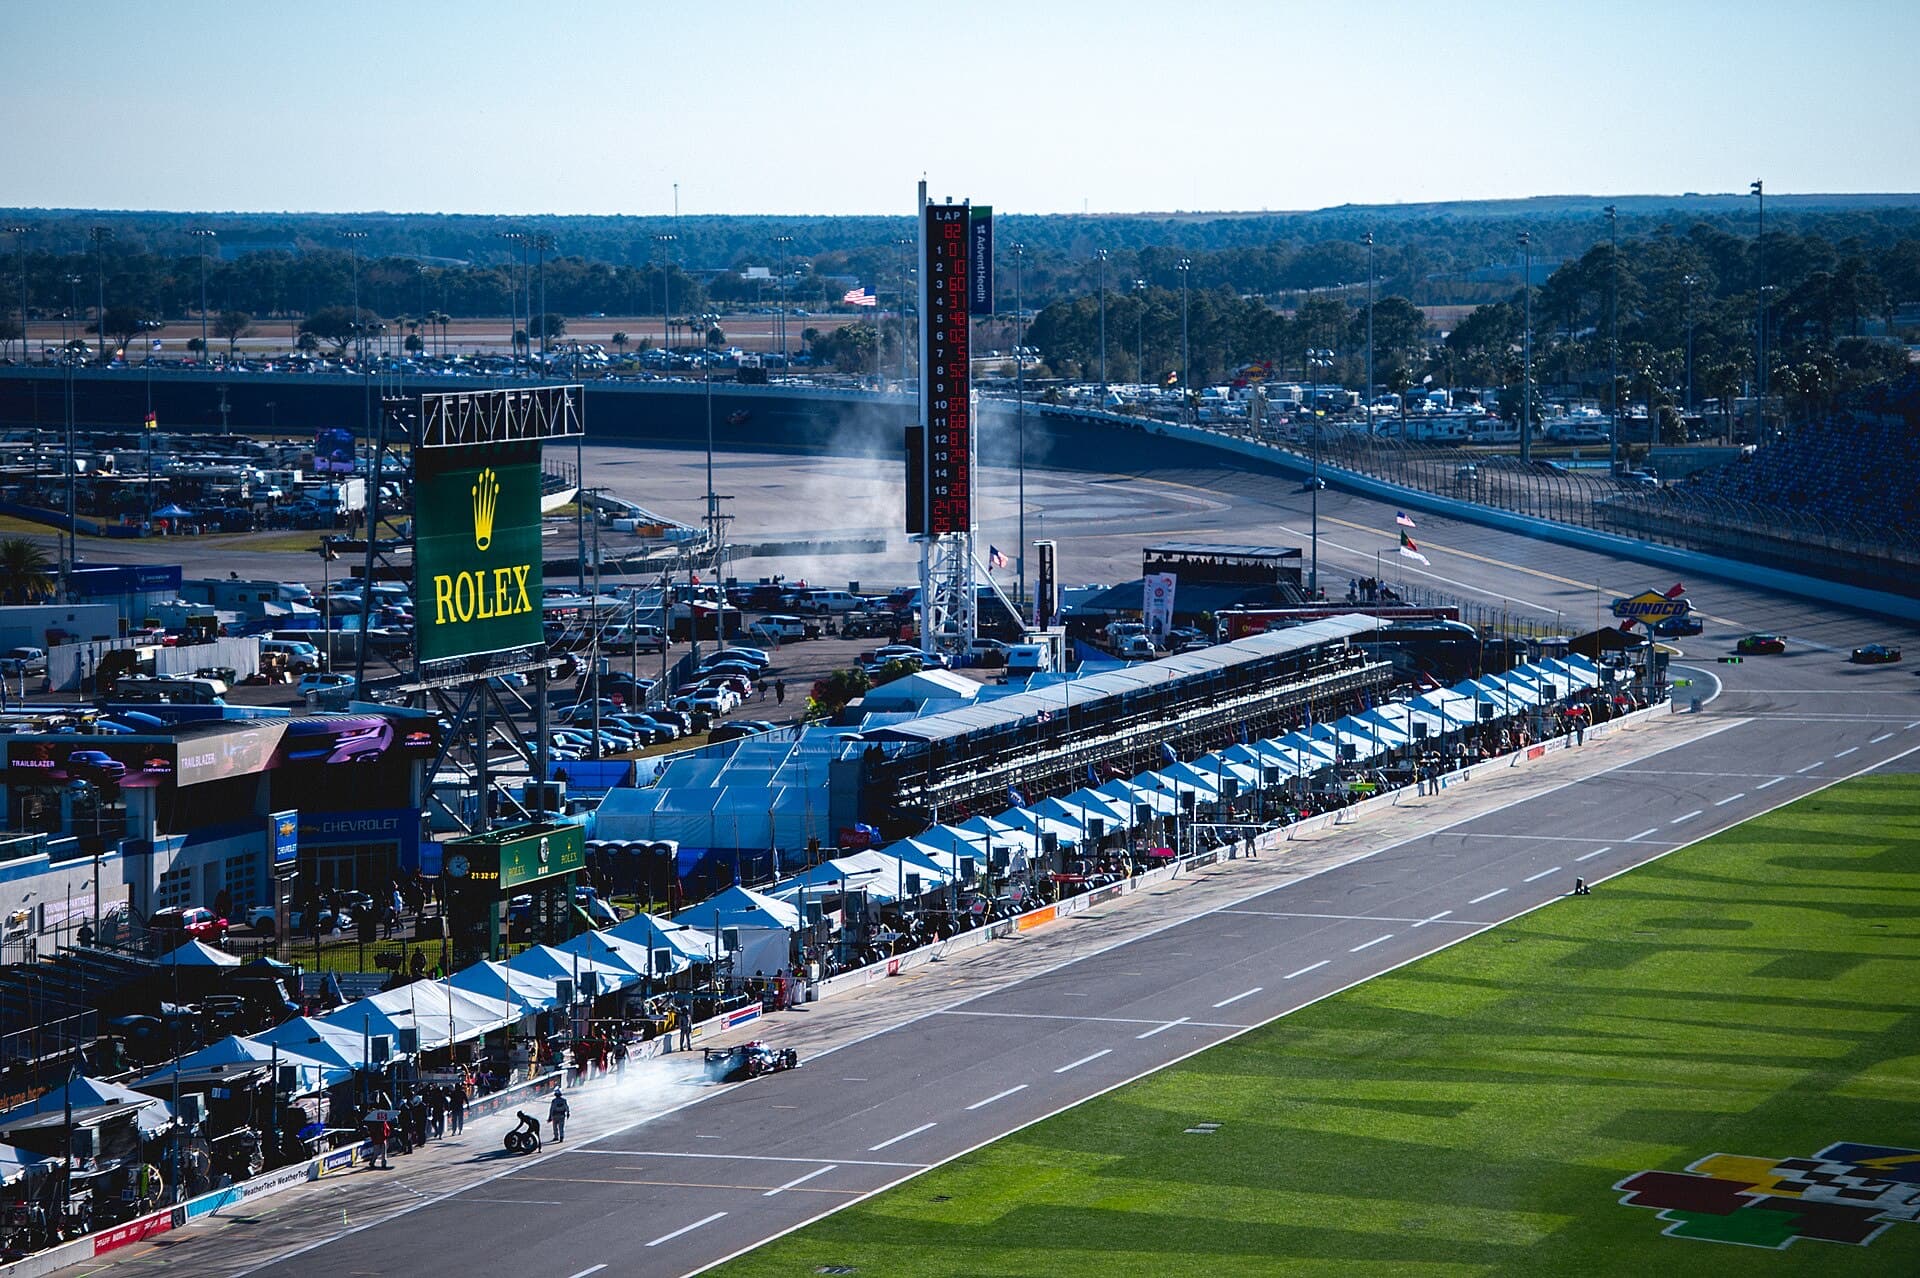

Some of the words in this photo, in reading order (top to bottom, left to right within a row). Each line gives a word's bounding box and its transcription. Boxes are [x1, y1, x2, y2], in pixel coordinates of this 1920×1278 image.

[936, 211, 961, 220] LAP
[944, 224, 961, 238] 82
[936, 246, 942, 254] 1
[936, 263, 943, 272] 2
[977, 236, 986, 302] AdventHealth
[936, 280, 943, 289] 3
[936, 297, 943, 306] 4
[936, 315, 943, 323] 5
[936, 332, 943, 340] 6
[936, 349, 943, 358] 7
[937, 366, 944, 375] 8
[937, 384, 944, 392] 9
[934, 401, 947, 409] 10
[934, 418, 946, 427] 11
[934, 435, 948, 444] 12
[935, 452, 948, 461] 13
[935, 469, 948, 478] 14
[935, 486, 948, 495] 15
[434, 565, 532, 625] ROLEX
[1618, 603, 1685, 615] SUNOCO
[11, 760, 55, 768] TRAILBLAZER
[181, 753, 216, 768] TRAILBLAZER
[323, 818, 399, 833] CHEVROLET
[277, 843, 297, 856] CHEVROLET
[243, 1180, 277, 1196] WeatherTech
